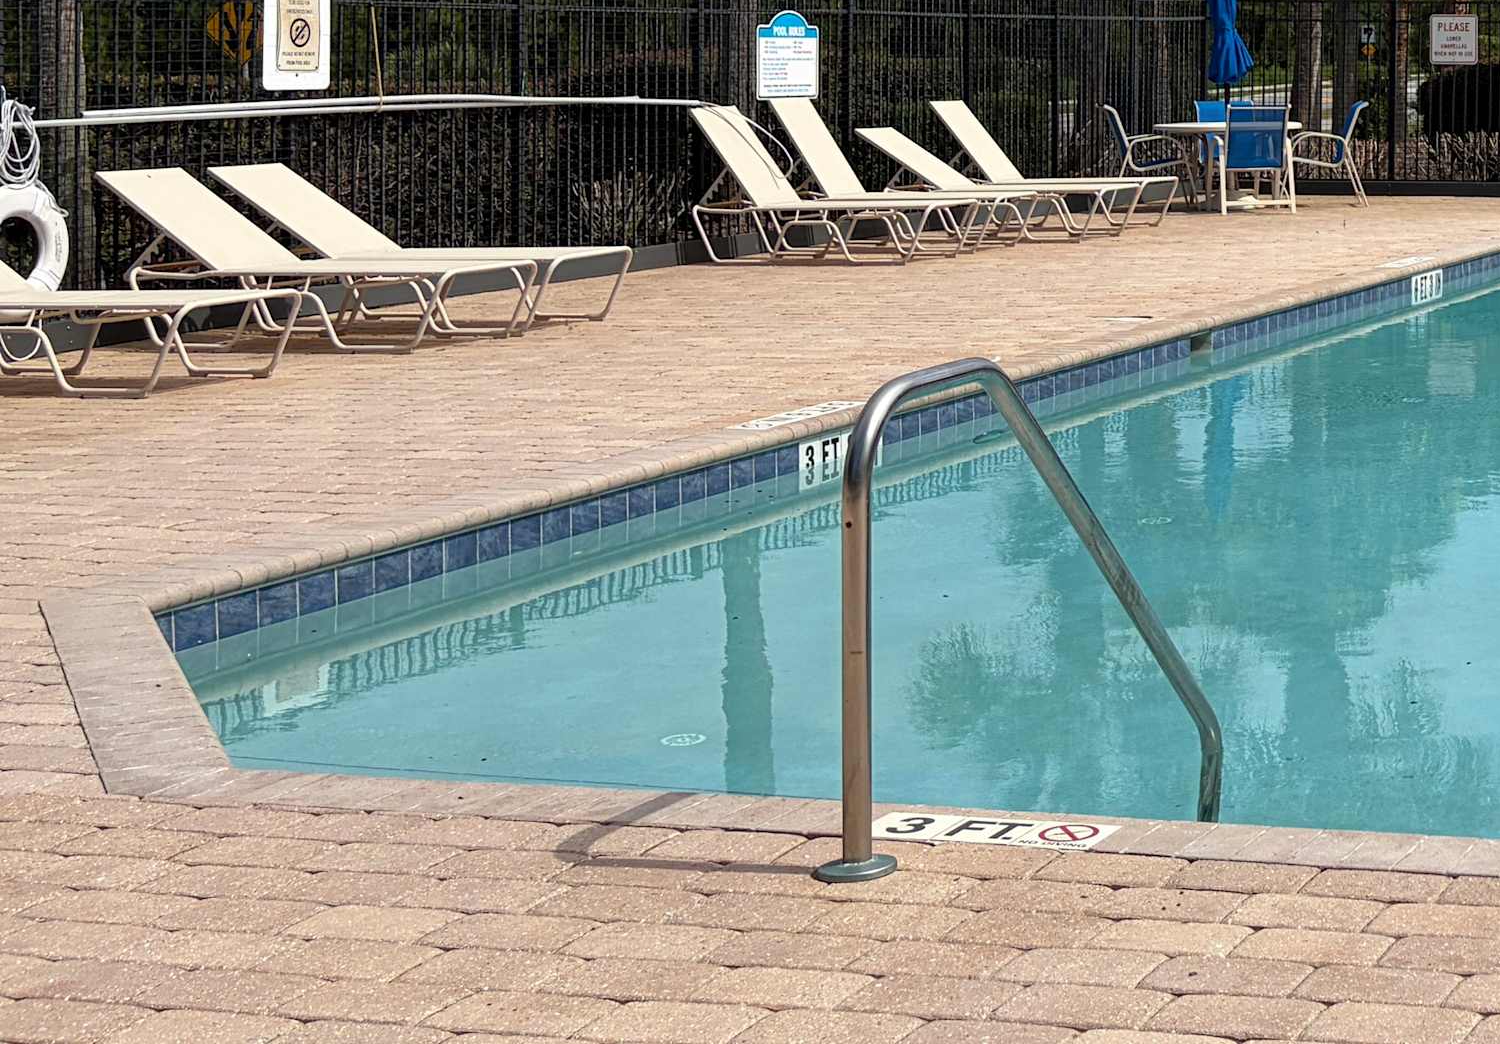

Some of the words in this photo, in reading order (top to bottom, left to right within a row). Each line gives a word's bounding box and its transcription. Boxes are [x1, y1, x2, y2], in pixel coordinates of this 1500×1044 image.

[1437, 22, 1472, 32] PLEASE
[805, 445, 815, 474] 3
[822, 437, 840, 468] FT
[885, 816, 936, 834] 3
[944, 819, 1034, 840] FT.
[1042, 840, 1087, 848] DIVING
